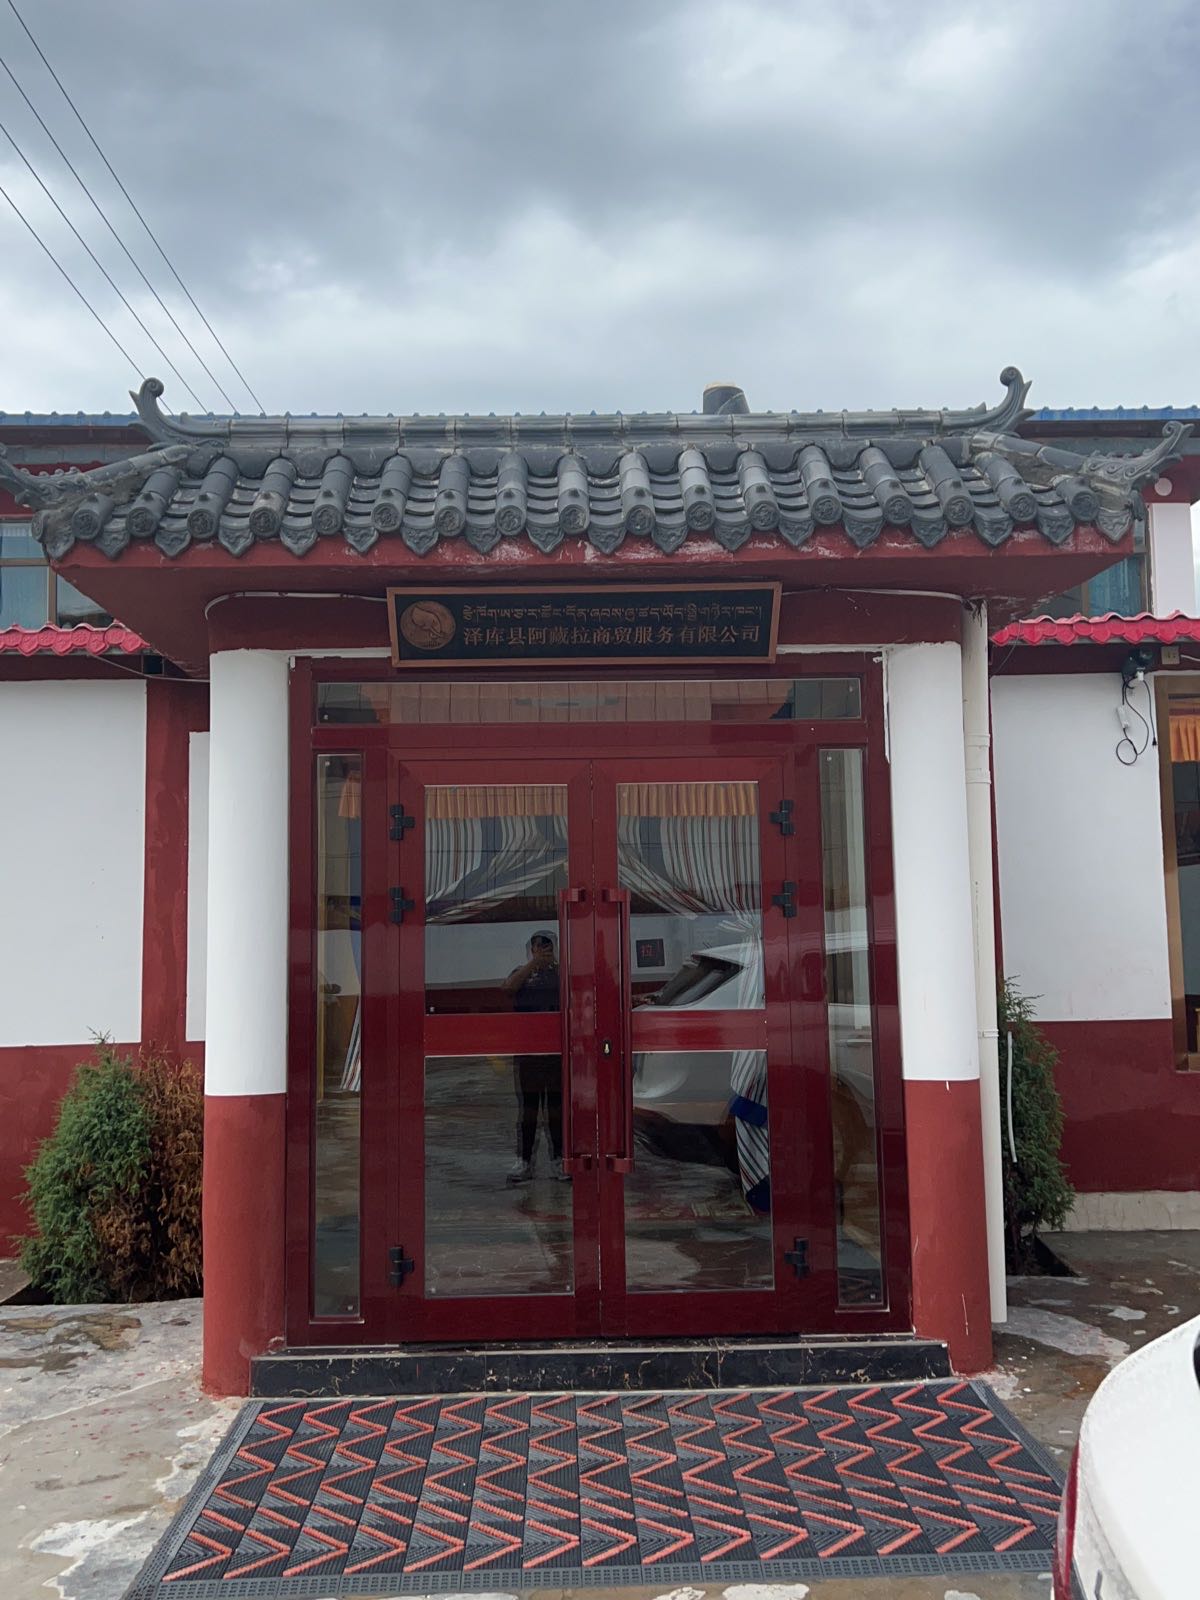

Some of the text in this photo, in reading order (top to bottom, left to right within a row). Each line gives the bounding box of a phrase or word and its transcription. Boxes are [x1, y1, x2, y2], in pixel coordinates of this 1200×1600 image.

[464, 625, 760, 645] 泽库县阿藏拉商贸服务有限公司
